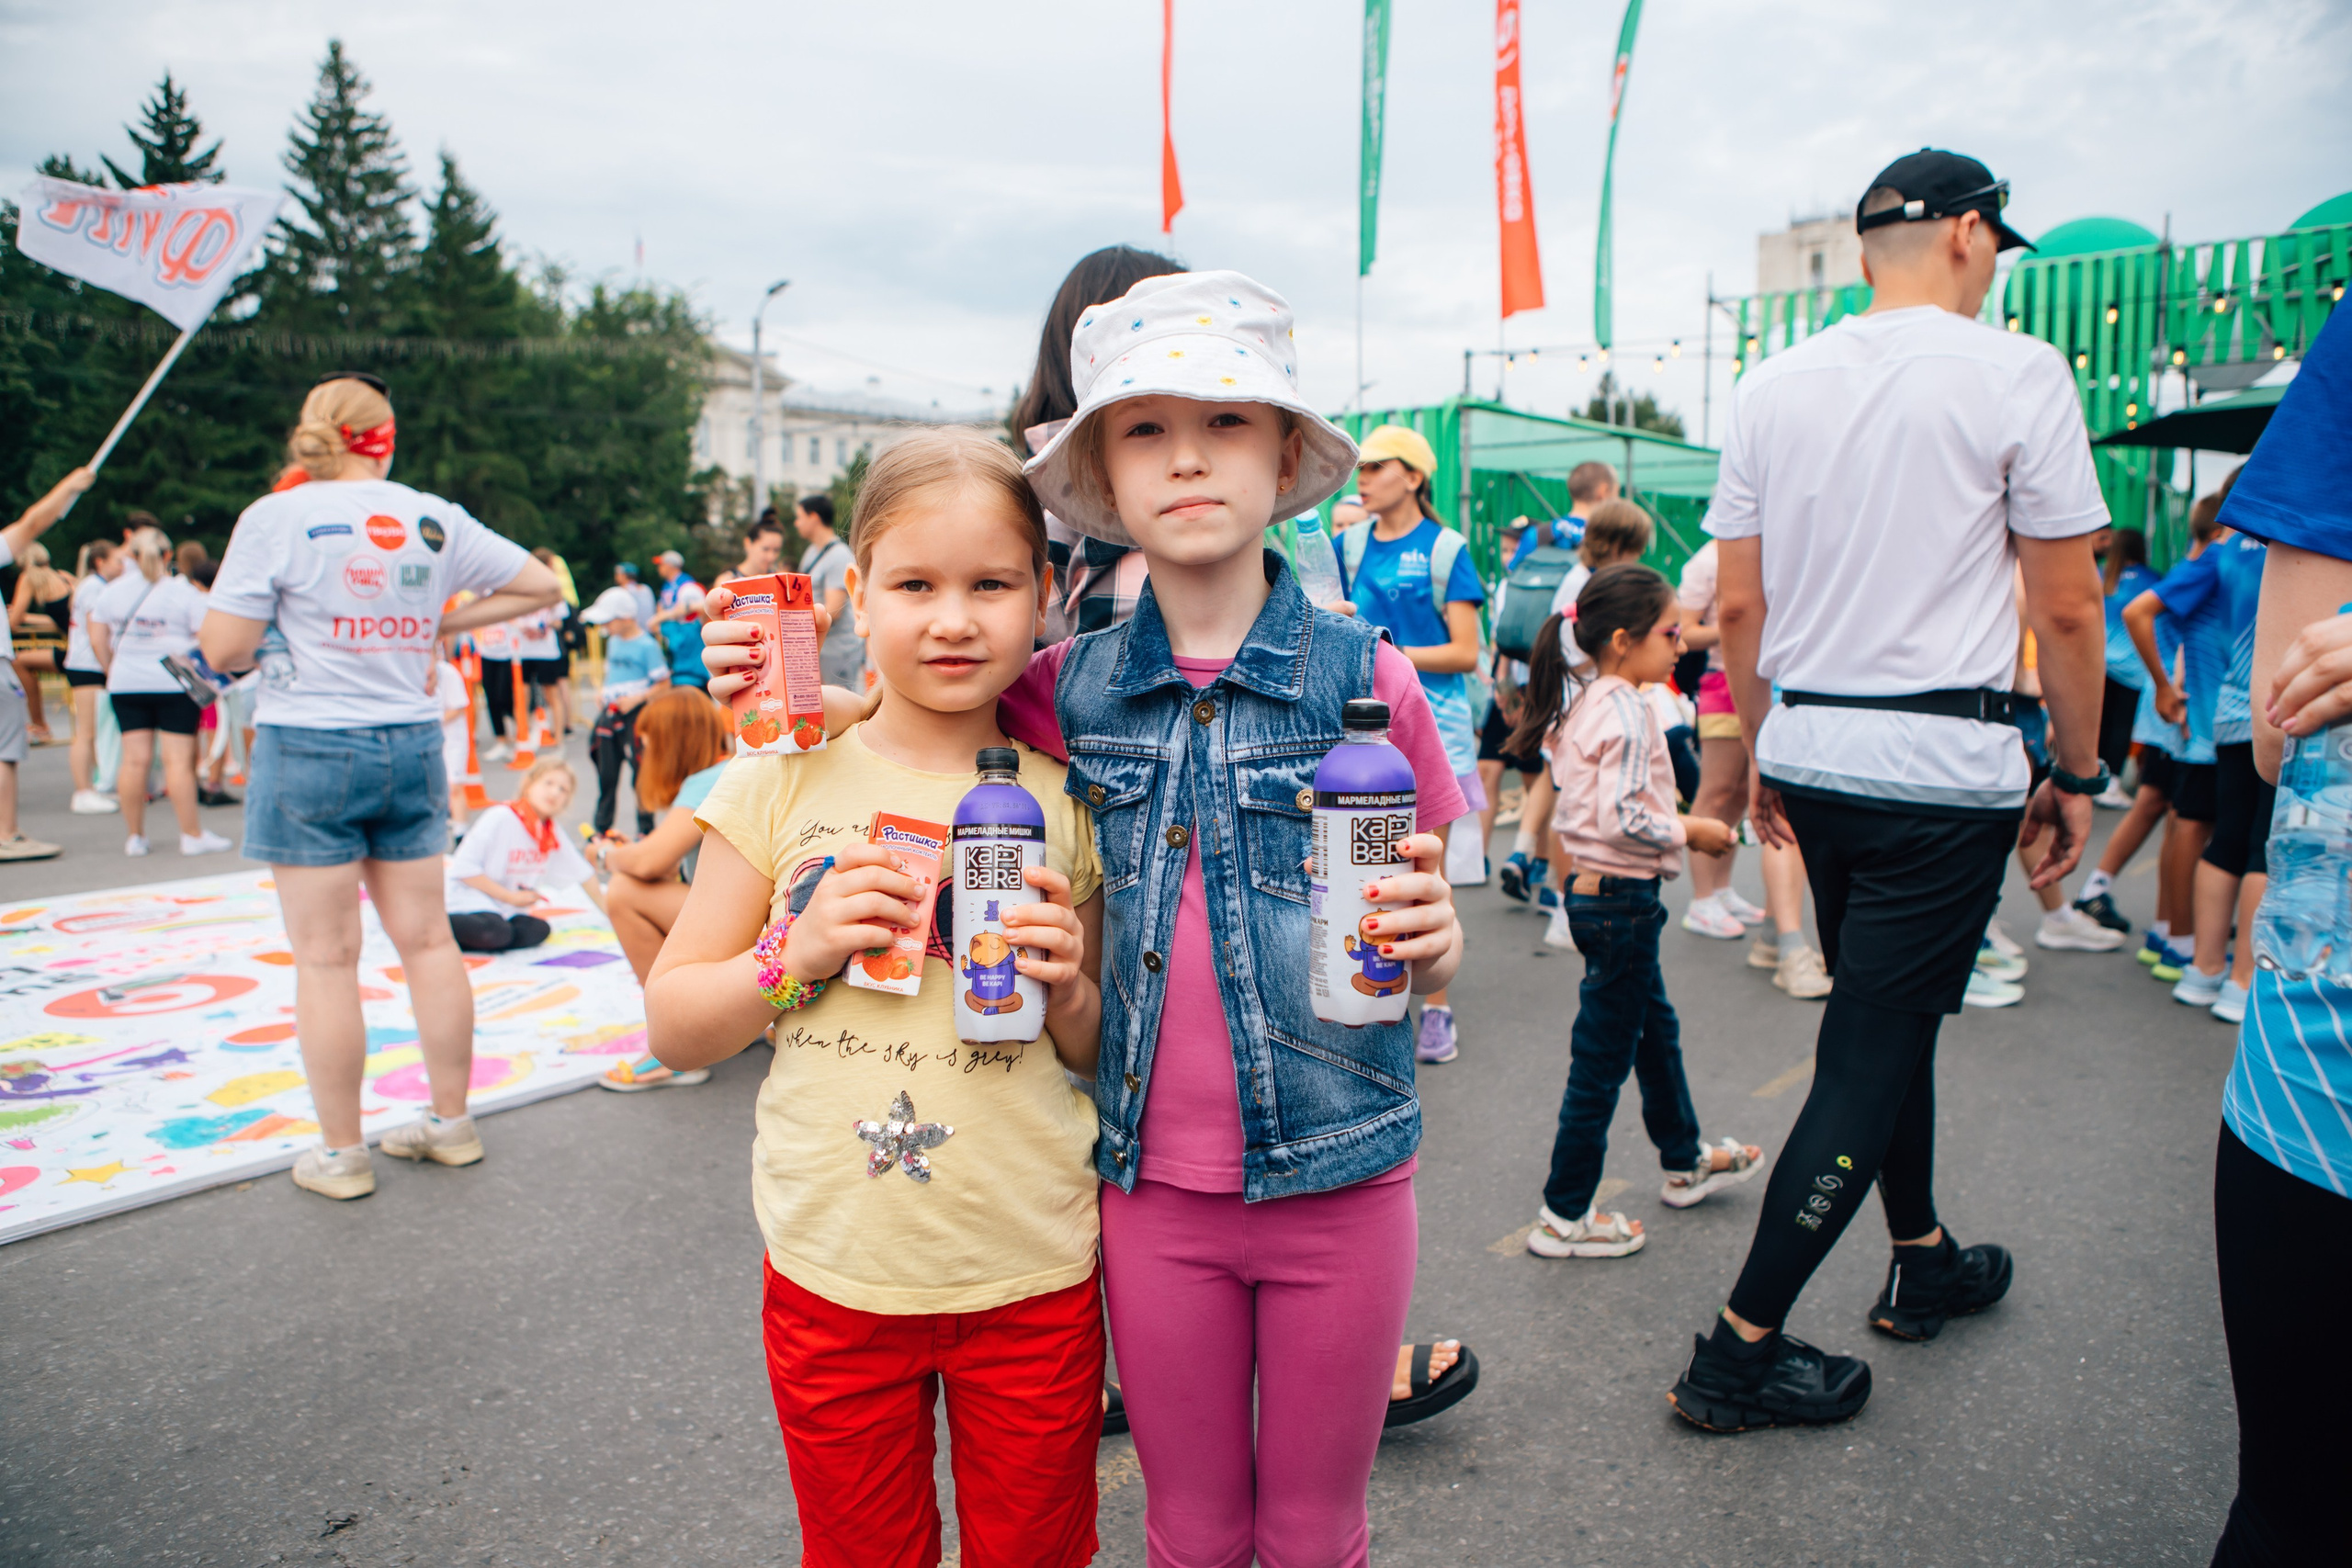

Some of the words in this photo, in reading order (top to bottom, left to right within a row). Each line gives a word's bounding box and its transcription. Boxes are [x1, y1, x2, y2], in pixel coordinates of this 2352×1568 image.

[1337, 795, 1401, 807] МАРМЕЛАДНЫЕ
[799, 818, 844, 847] You
[852, 824, 870, 837] ar
[882, 825, 939, 850] Растишка
[956, 827, 1009, 837] МАРМЕЛАДНЫЕ
[1009, 828, 1033, 836] МИШКИ
[837, 1030, 876, 1057] the
[884, 1042, 928, 1071] sky
